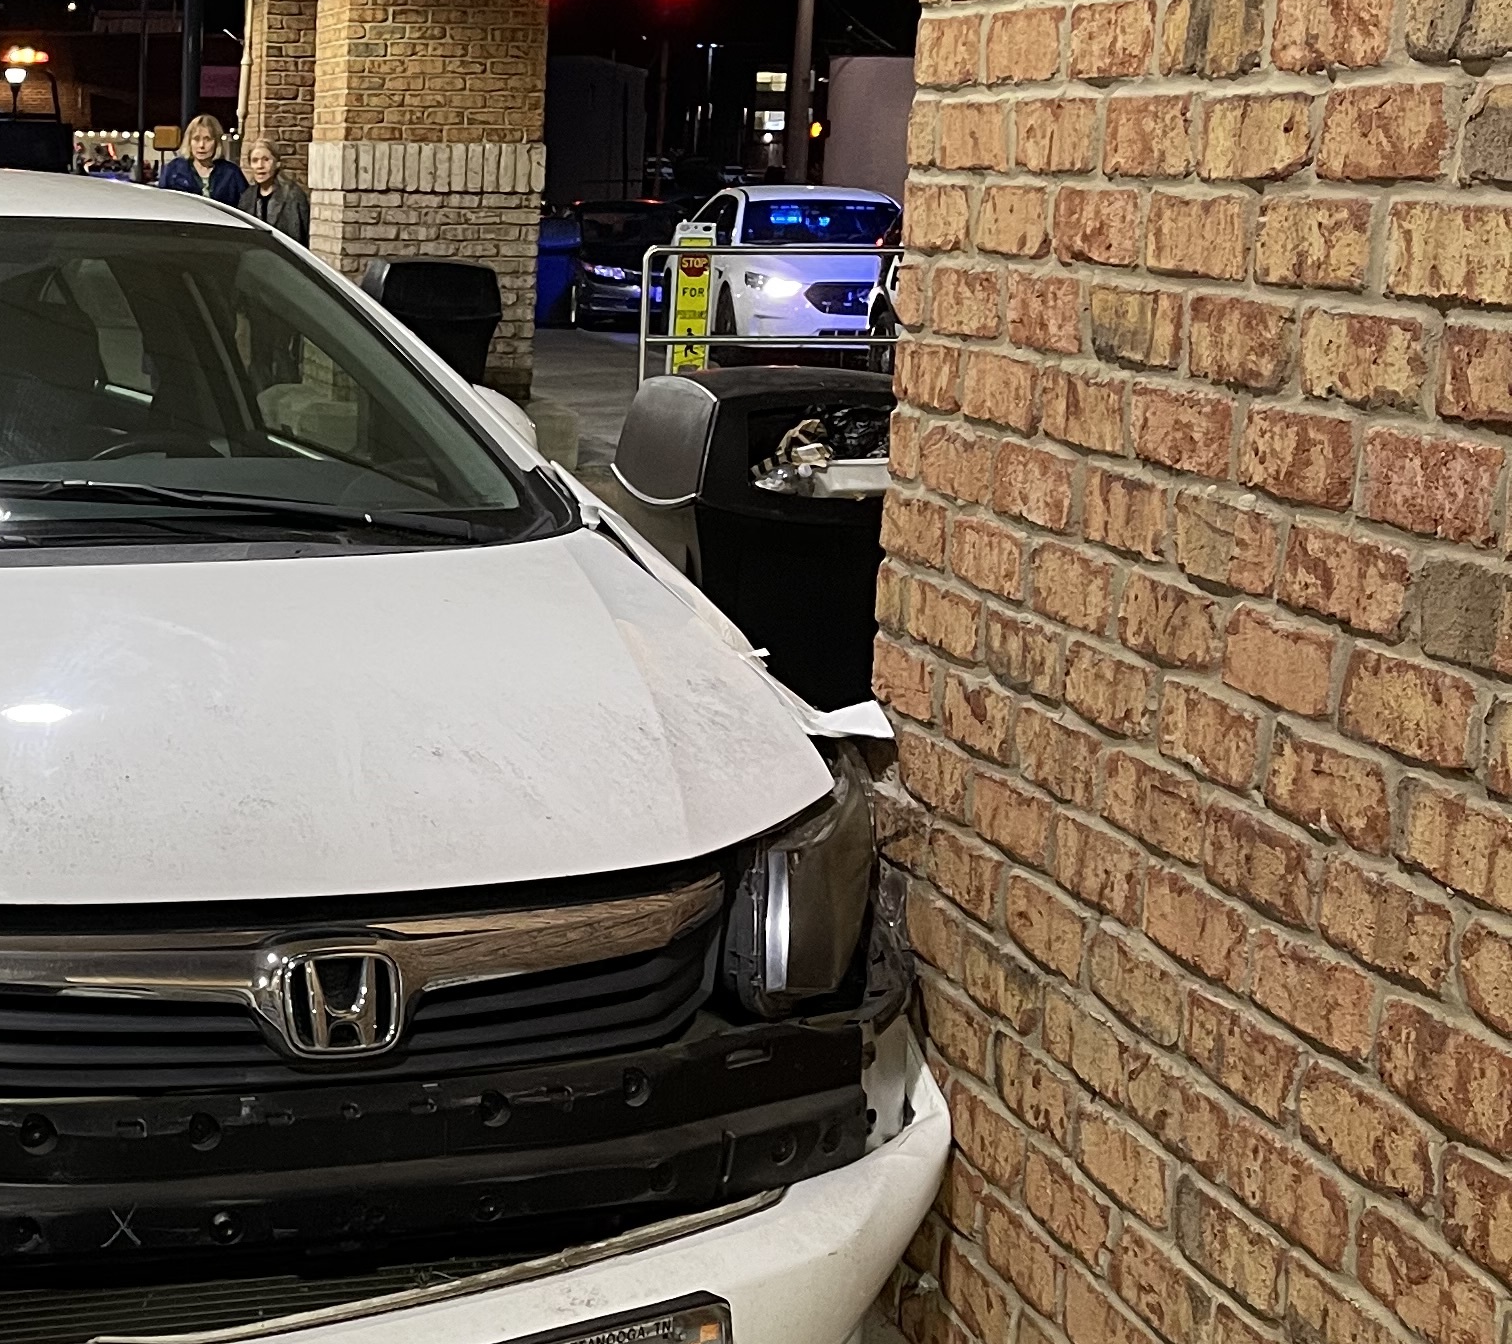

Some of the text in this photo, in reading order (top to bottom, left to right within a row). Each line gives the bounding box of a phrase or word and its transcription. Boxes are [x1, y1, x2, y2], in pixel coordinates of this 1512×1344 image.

[681, 257, 708, 269] STOP
[681, 287, 705, 298] FOR
[654, 1320, 672, 1335] TN
